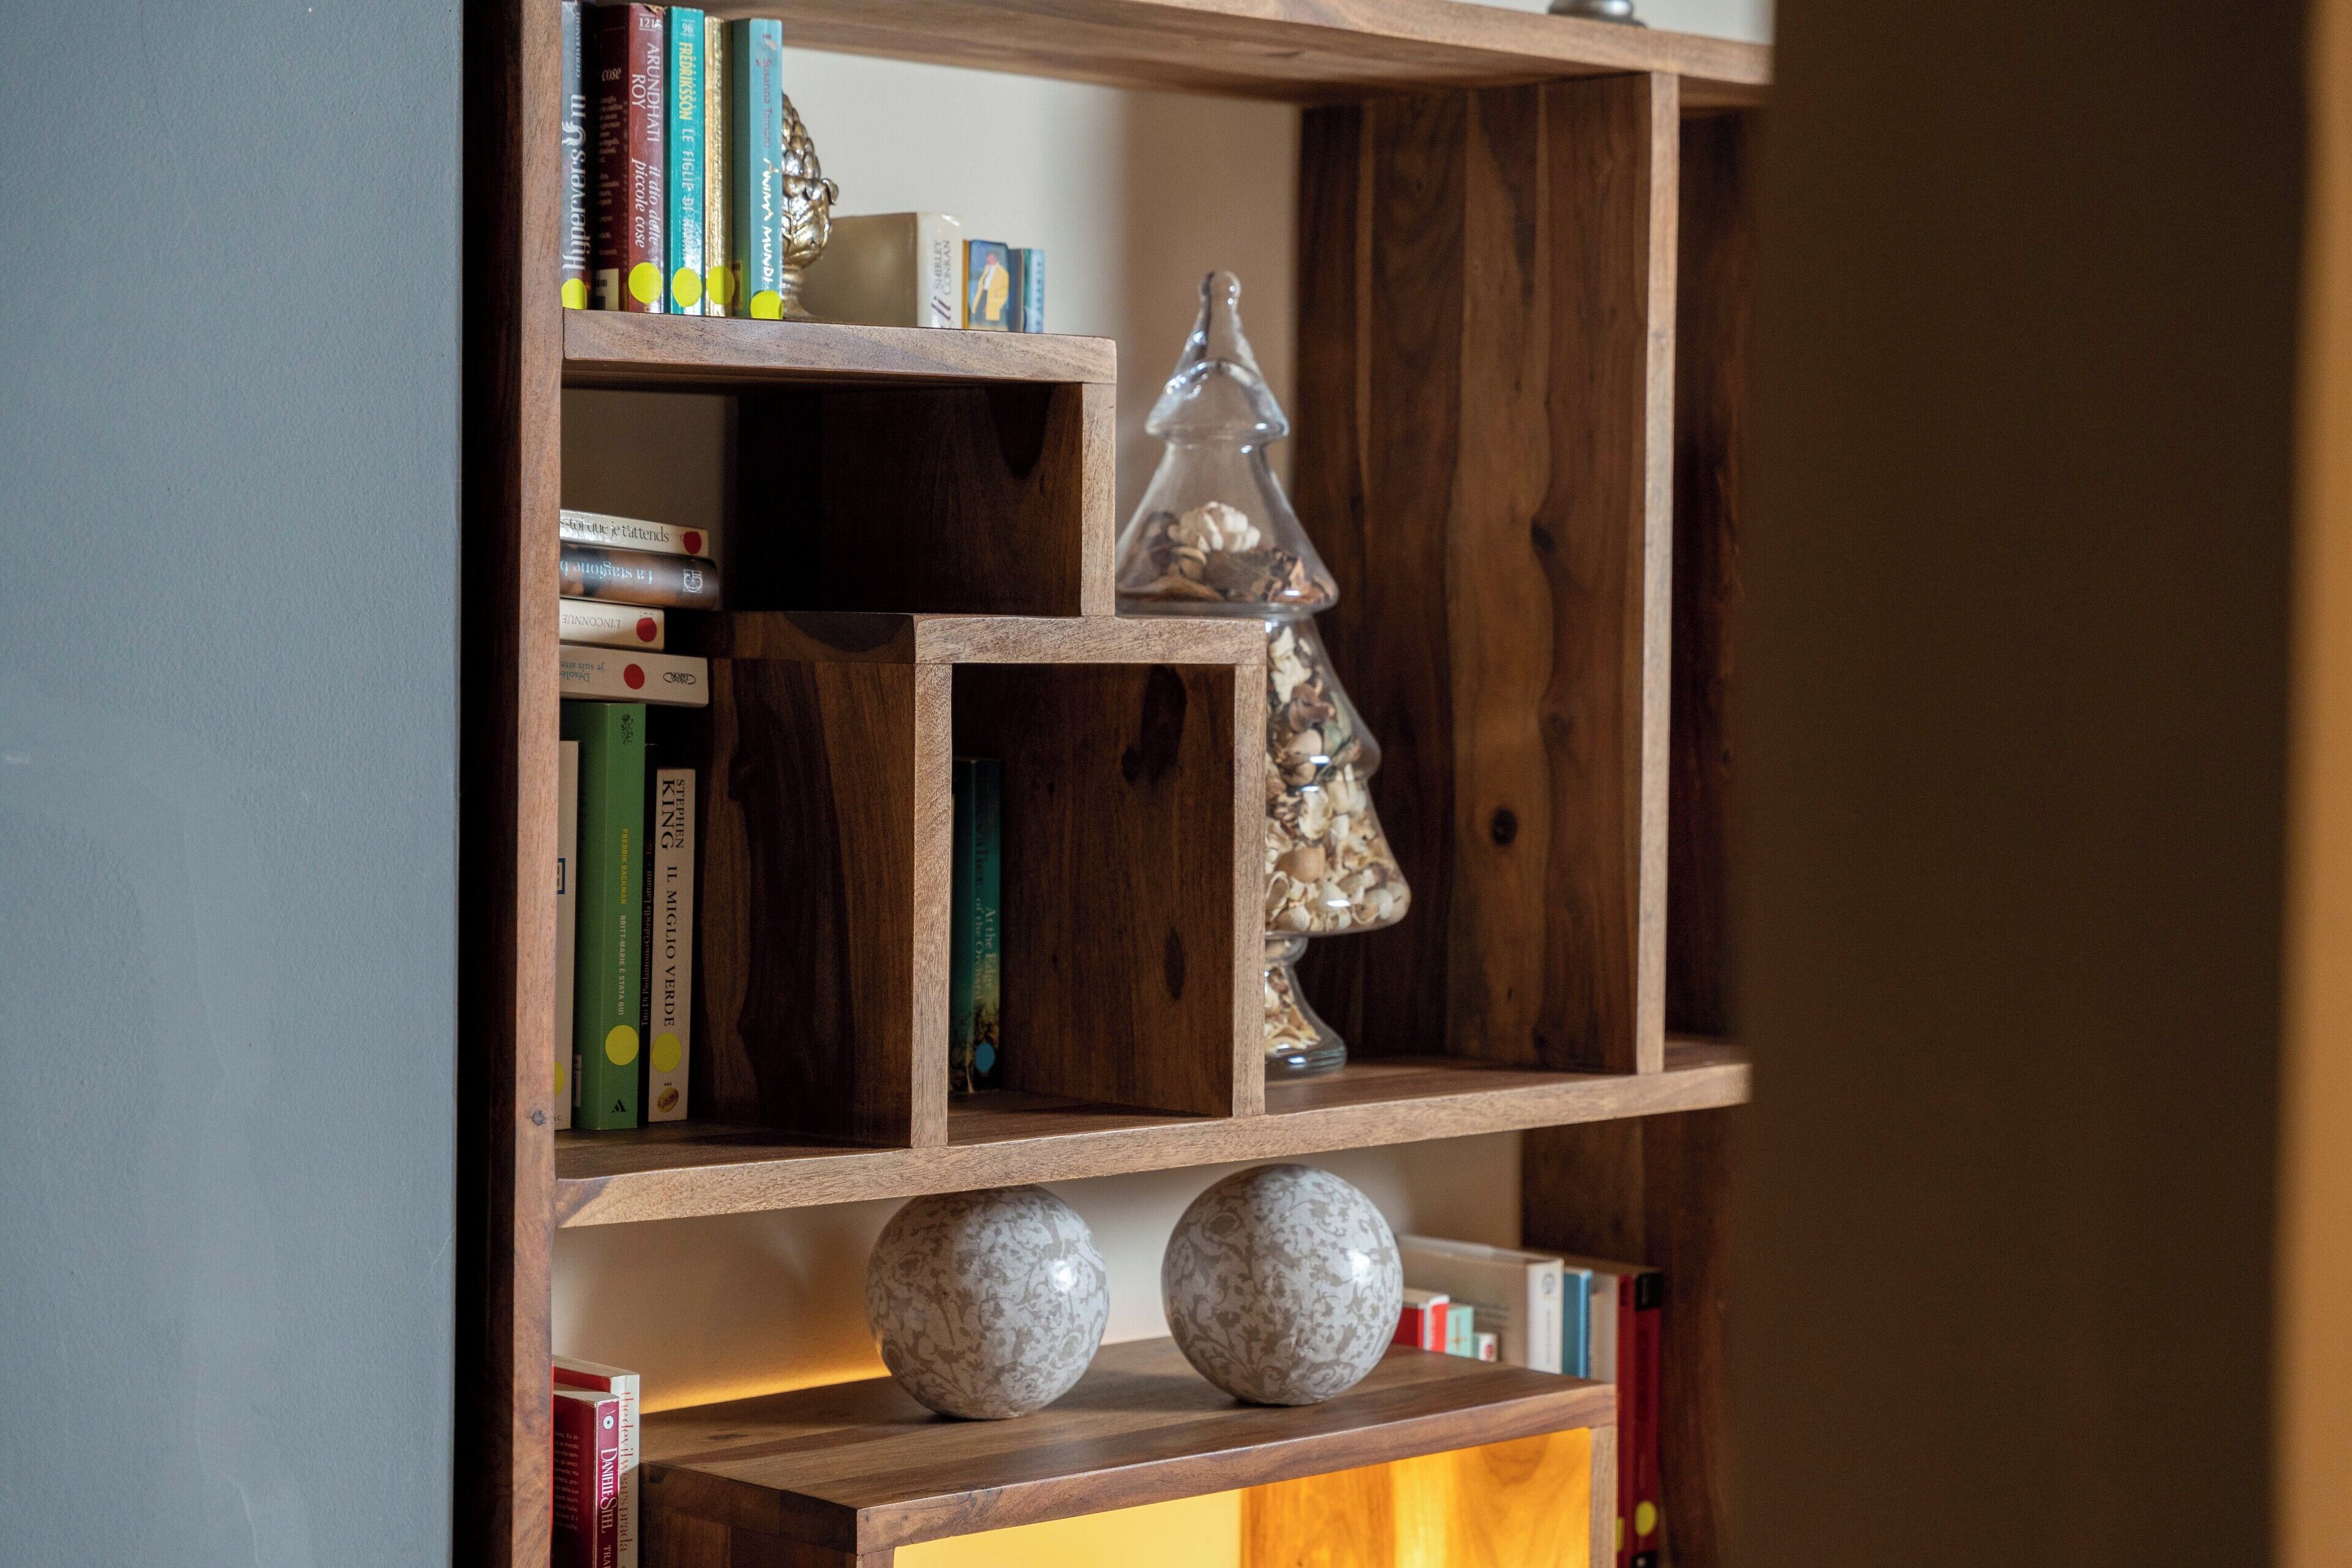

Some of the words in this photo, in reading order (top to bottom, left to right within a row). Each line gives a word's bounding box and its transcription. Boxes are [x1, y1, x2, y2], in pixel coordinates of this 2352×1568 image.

[601, 67, 620, 80] cose
[631, 74, 646, 110] ROY
[646, 43, 661, 142] ARUNDHATI
[682, 128, 695, 142] LE
[649, 165, 661, 177] il
[682, 151, 695, 189] FIGLIE
[632, 159, 647, 211] piccole
[649, 180, 661, 204] dio
[682, 197, 695, 212] DI
[635, 216, 646, 248] cose
[647, 208, 662, 246] delle
[761, 226, 775, 283] MUNDI
[933, 239, 943, 290] SHIRLEY
[941, 240, 951, 295] CONRAN
[587, 522, 608, 535] que
[610, 520, 621, 539] je
[622, 526, 669, 543] t'attends
[573, 560, 632, 580] stagione
[636, 569, 654, 584] La
[562, 614, 620, 628] L'INCONNUE
[578, 662, 595, 672] suis
[597, 662, 606, 671] je
[661, 780, 676, 851] KING
[675, 779, 685, 850] STEPHEN
[620, 829, 629, 863] FREDRIK
[666, 865, 677, 883] IL
[644, 870, 653, 903] Lattanzi
[975, 897, 984, 911] of
[985, 908, 996, 922] At
[665, 891, 677, 960] MIGLIO
[974, 916, 984, 935] the
[985, 927, 996, 949] the
[642, 997, 650, 1008] Di
[664, 966, 677, 1027] VERDE
[641, 1009, 650, 1027] Tito
[600, 1447, 618, 1497] DANIELLE
[600, 1496, 617, 1534] STEEL
